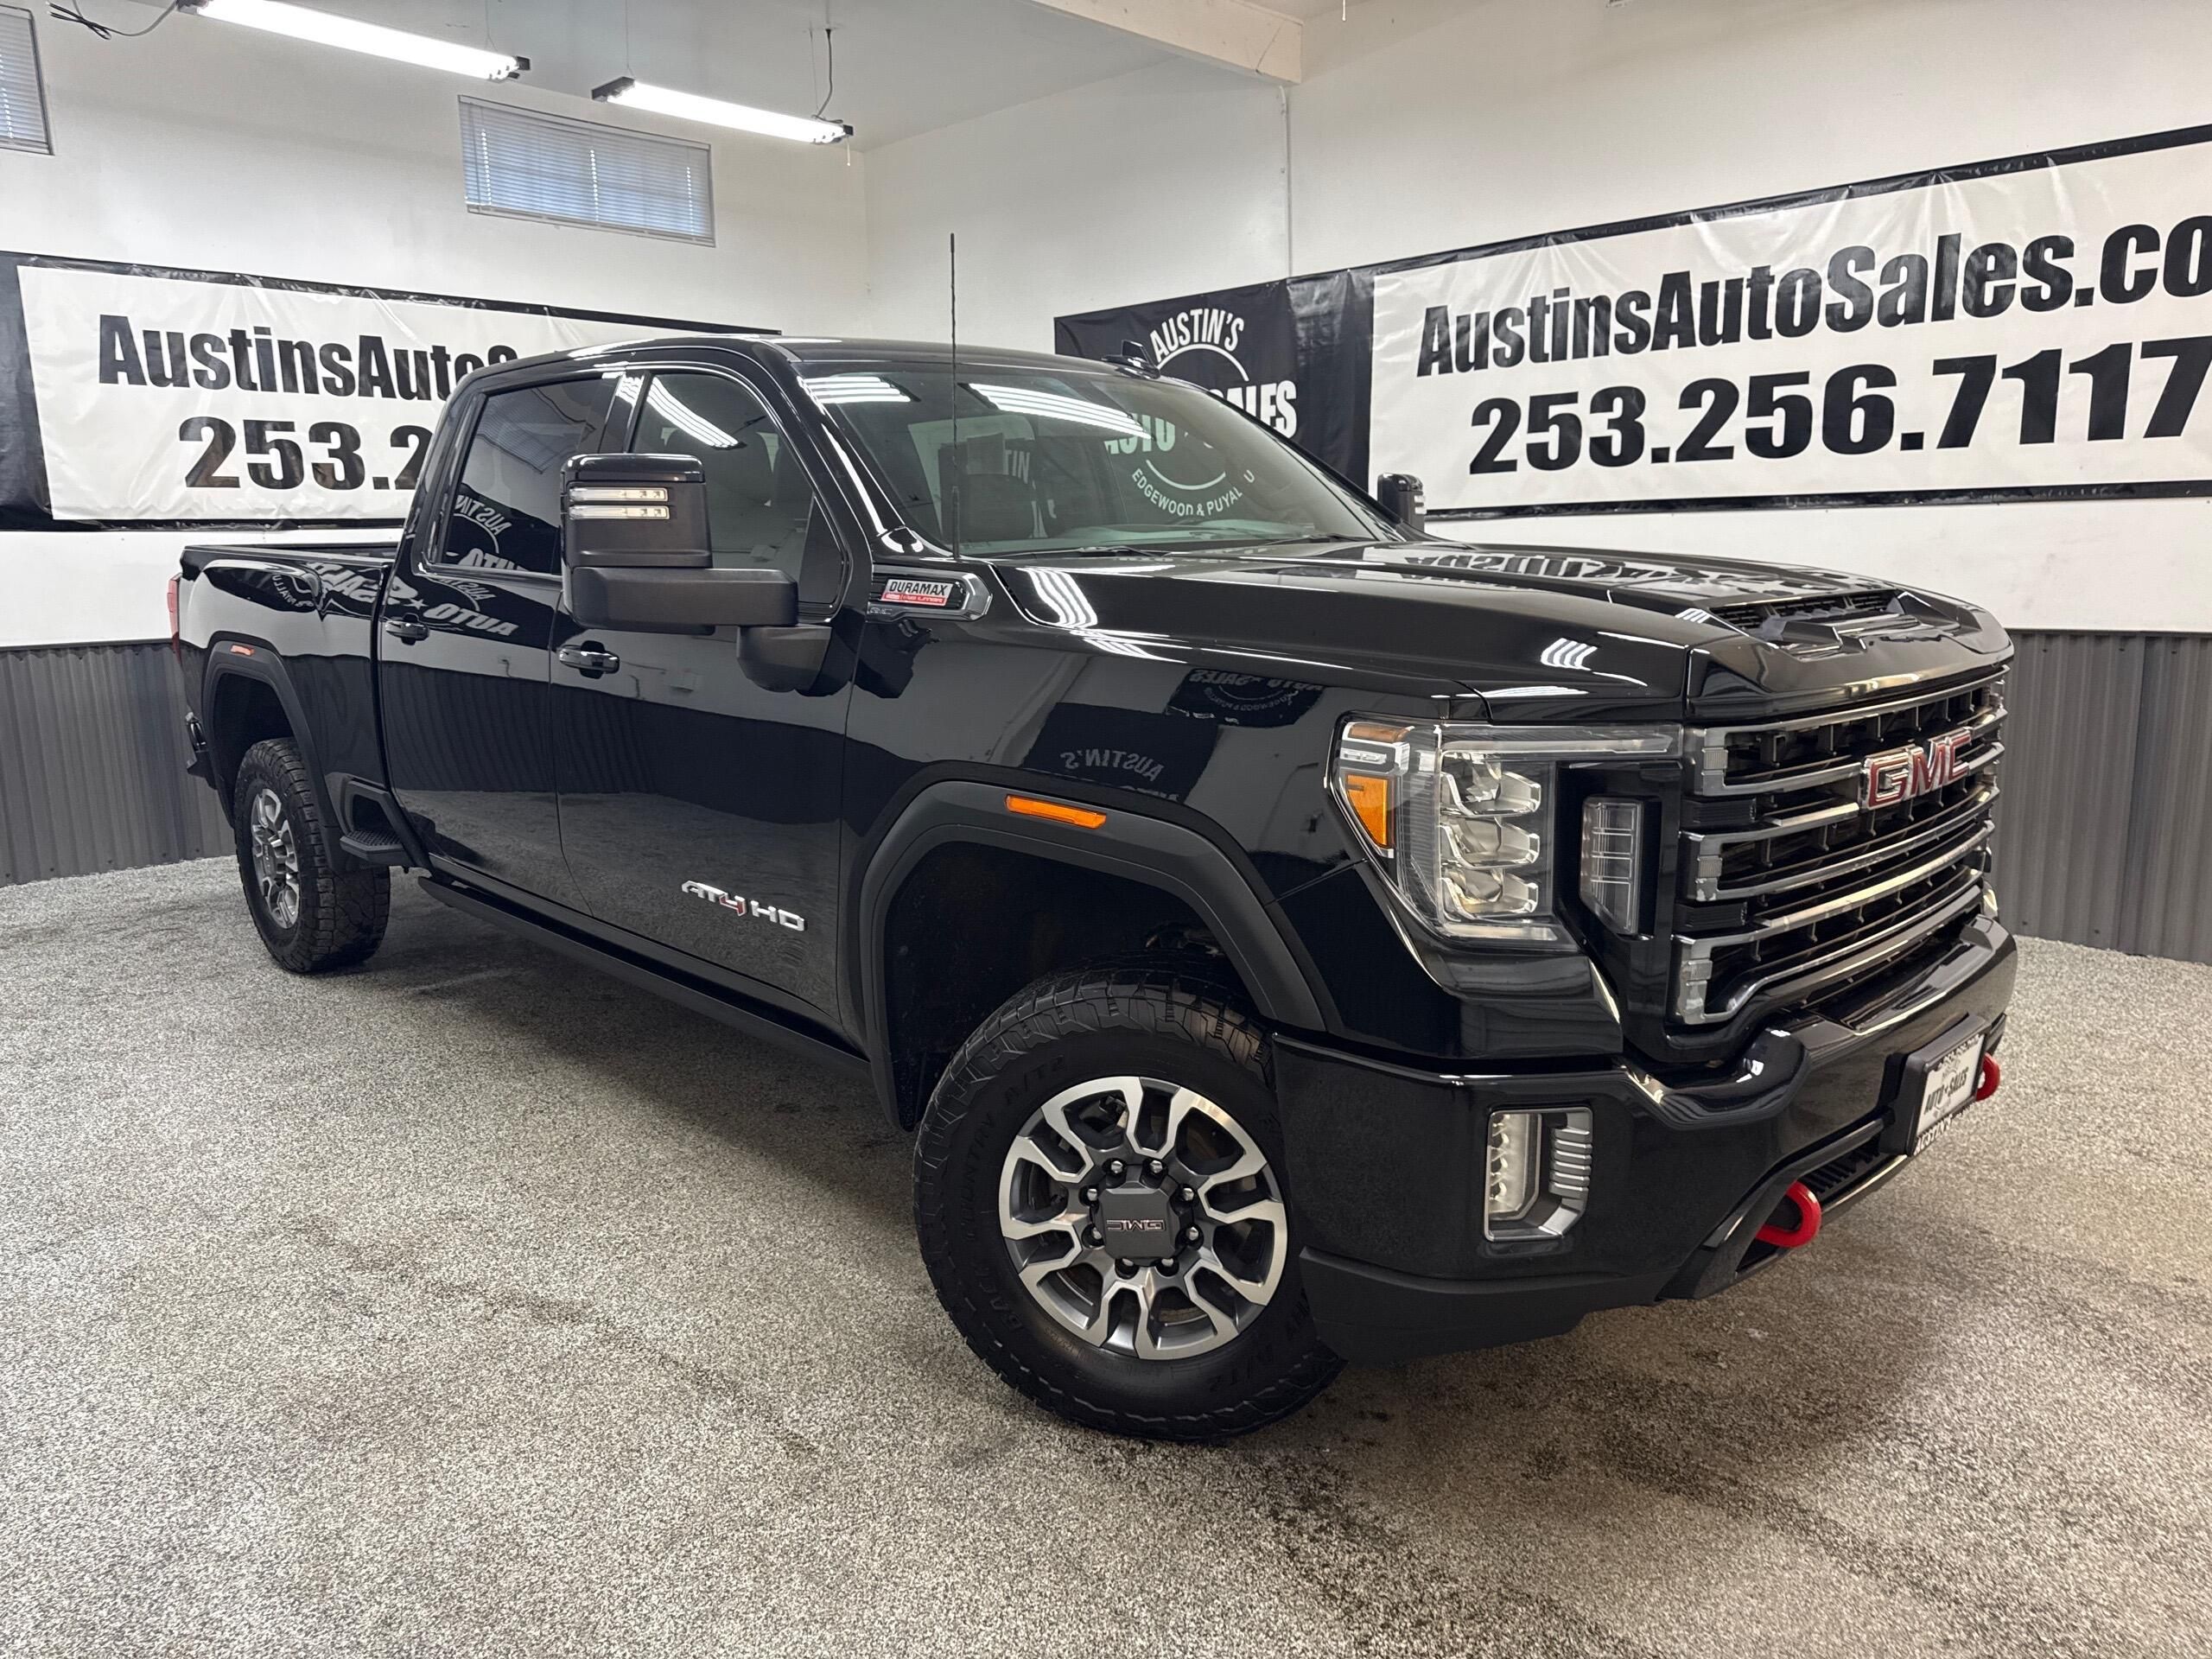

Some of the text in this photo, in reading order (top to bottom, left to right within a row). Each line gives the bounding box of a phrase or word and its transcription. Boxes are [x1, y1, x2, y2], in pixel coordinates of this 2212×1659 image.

[1415, 215, 2212, 378] AustinsAutoSales.co
[1149, 308, 1245, 362] AUSTIN'S
[1469, 334, 2212, 475] 253.256.7117
[1132, 467, 1193, 517] EDGEWOOD
[1196, 503, 1205, 517] &
[889, 581, 949, 596] DURAMAX
[1865, 728, 1973, 810] GMC
[681, 880, 805, 931] AT4 HD
[1106, 1219, 1166, 1231] GMC
